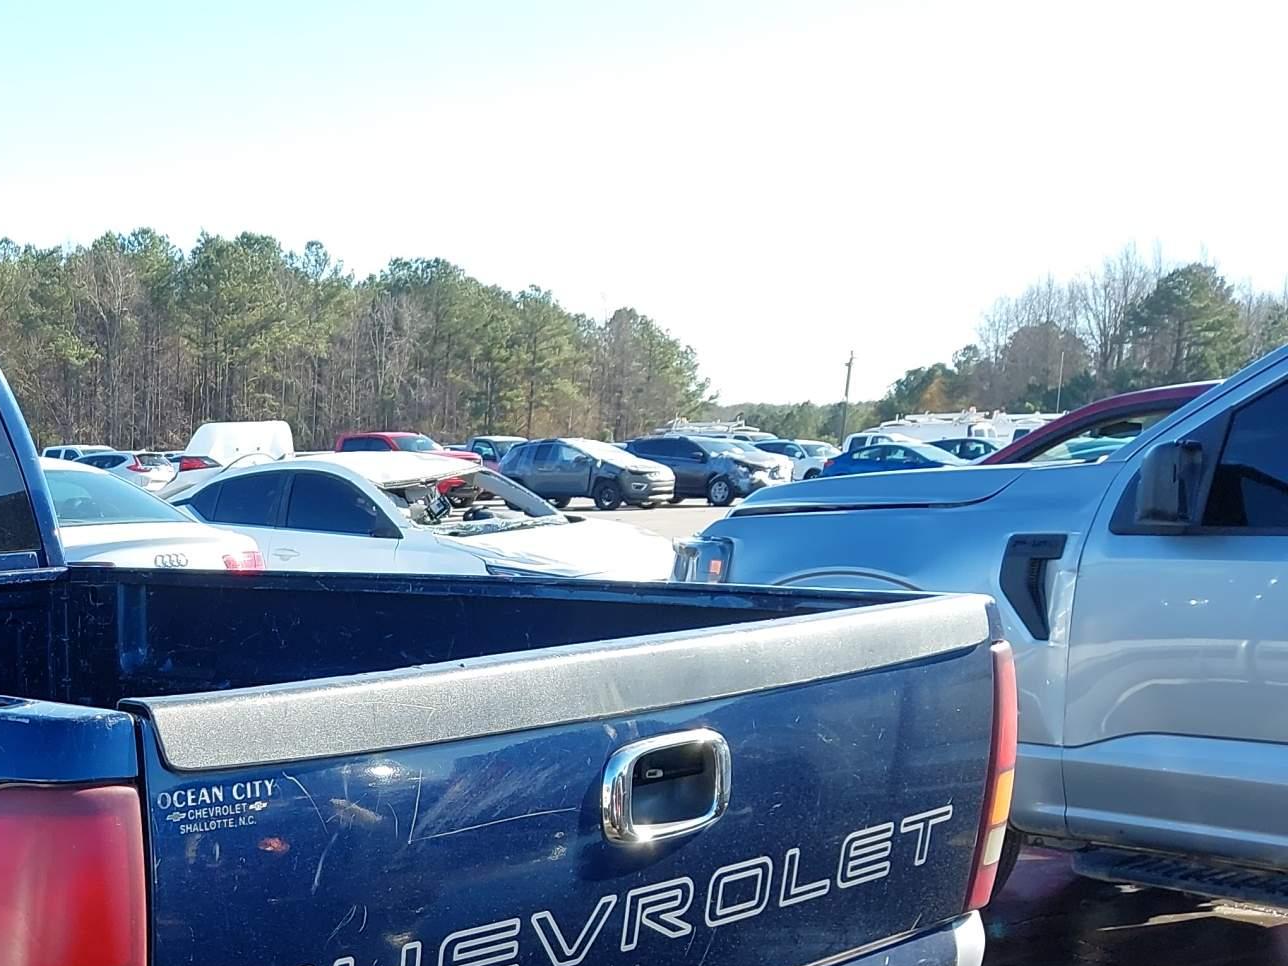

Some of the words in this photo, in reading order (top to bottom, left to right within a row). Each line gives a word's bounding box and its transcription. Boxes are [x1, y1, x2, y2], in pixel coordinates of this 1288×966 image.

[157, 784, 224, 809] OCEAN
[232, 778, 275, 800] CITY
[187, 802, 249, 820] CHEVROLET
